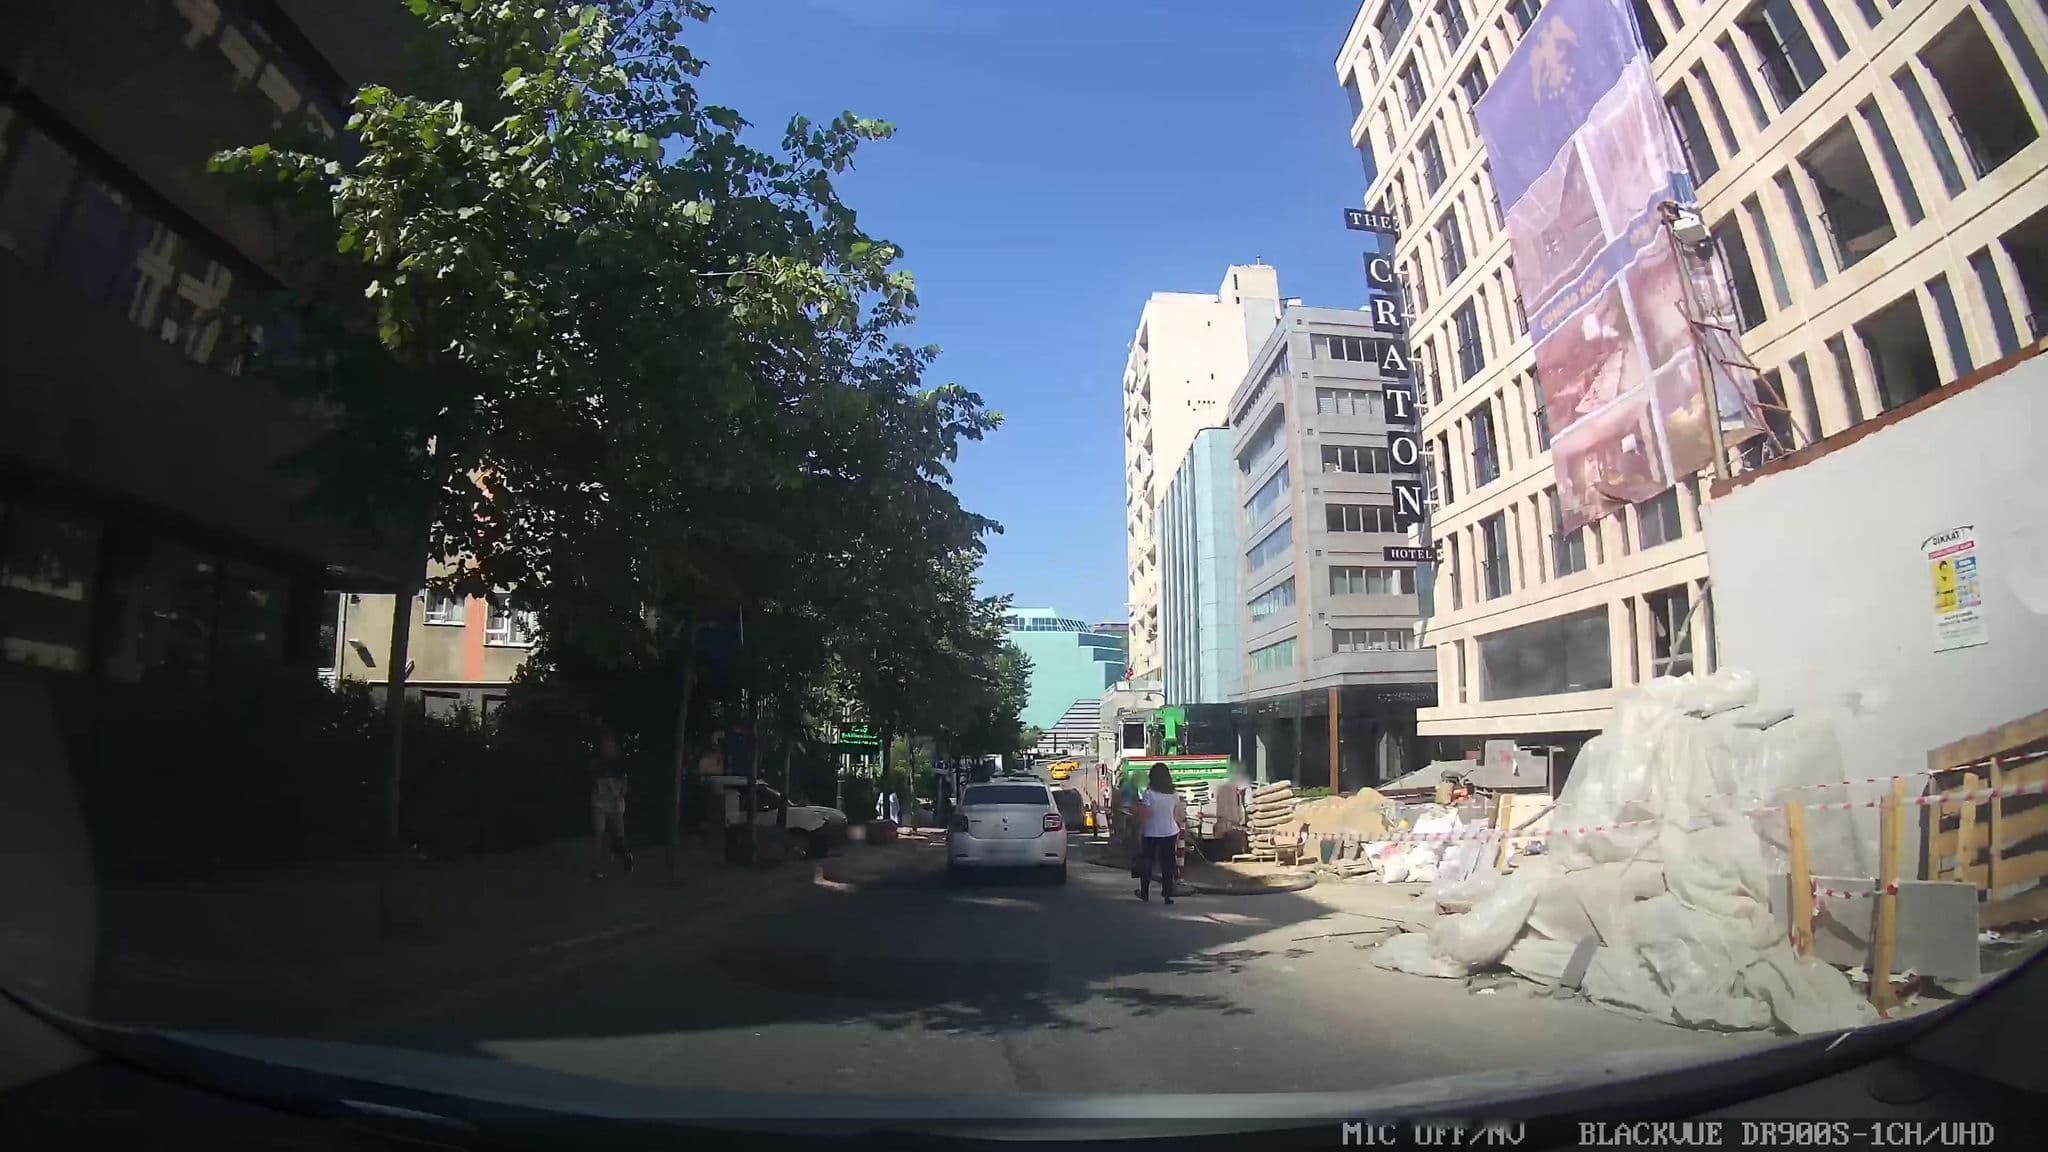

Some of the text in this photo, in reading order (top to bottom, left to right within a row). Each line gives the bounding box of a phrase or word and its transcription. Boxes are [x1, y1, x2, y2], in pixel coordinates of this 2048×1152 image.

[1349, 211, 1392, 229] THE
[1369, 257, 1421, 517] CRATON
[1391, 549, 1433, 559] HOTEL
